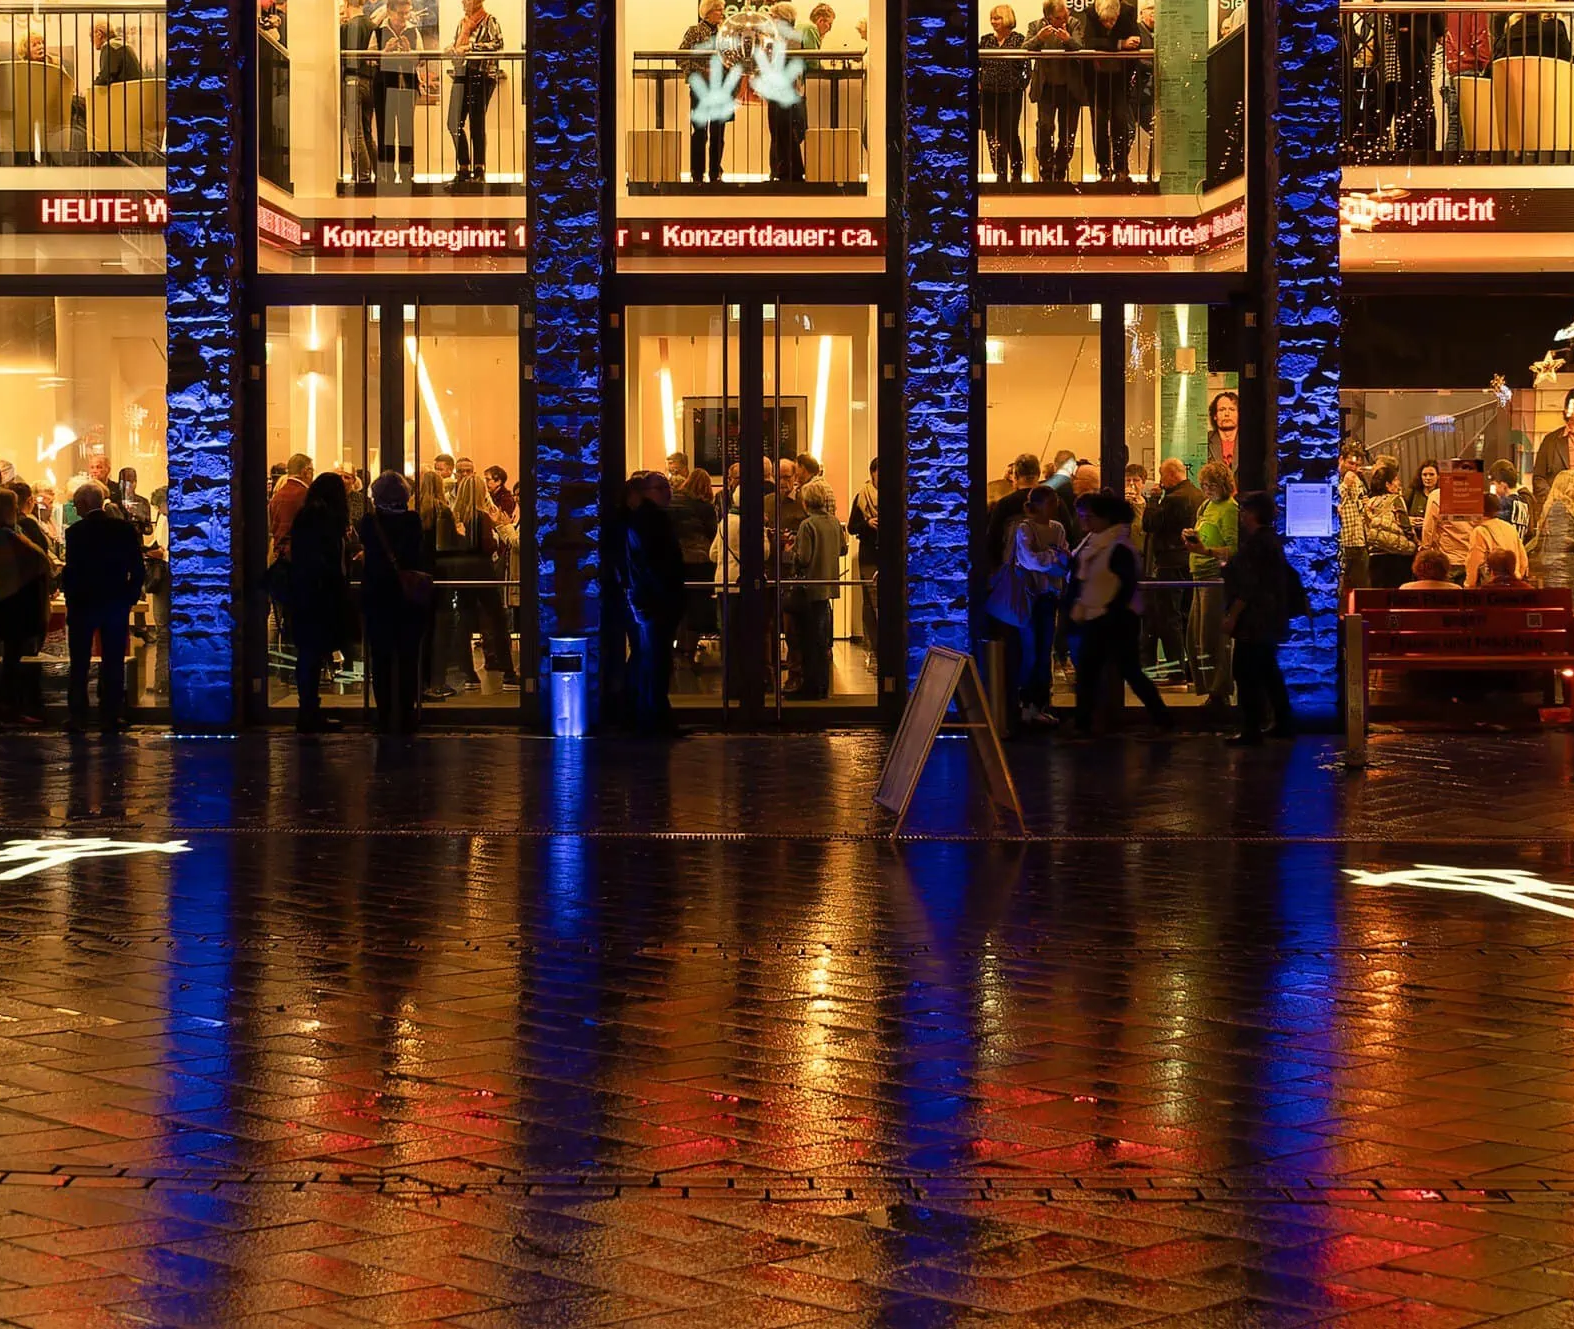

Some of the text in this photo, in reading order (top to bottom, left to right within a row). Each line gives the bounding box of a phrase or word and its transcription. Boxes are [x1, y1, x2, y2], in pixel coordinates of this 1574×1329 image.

[41, 199, 138, 222] HEUTE:
[322, 225, 506, 251] Konzertbeginn:
[662, 224, 836, 247] Konzertdauer:
[841, 229, 879, 247] ca.
[1020, 224, 1070, 247] inkl.
[1076, 224, 1106, 247] 25
